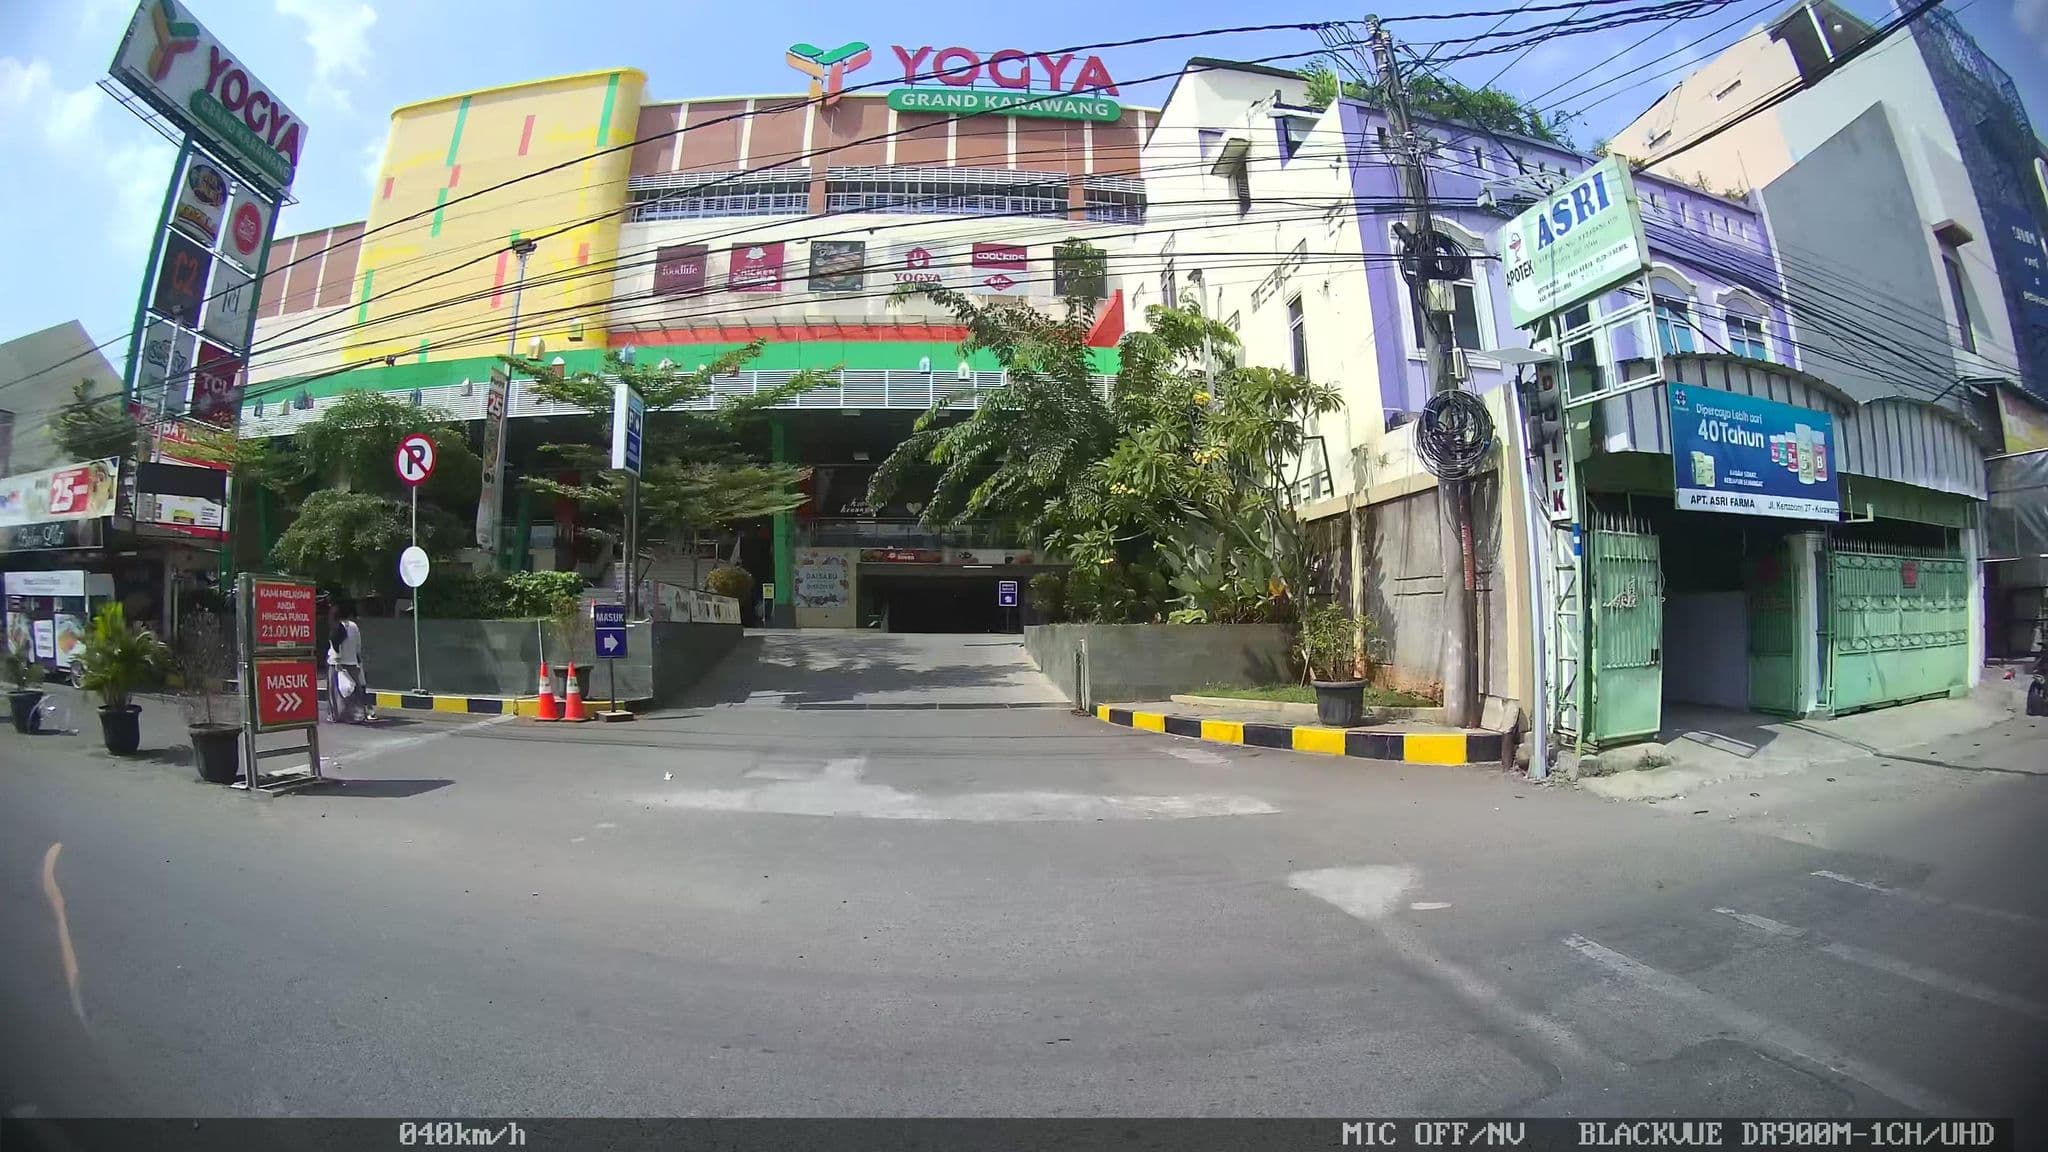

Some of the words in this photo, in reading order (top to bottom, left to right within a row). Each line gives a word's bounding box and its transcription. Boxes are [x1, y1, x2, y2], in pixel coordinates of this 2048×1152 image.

[890, 45, 1120, 97] YOGYA
[204, 45, 301, 168] YOGYA
[901, 93, 978, 108] GRAND
[984, 95, 1109, 117] KARAWANG
[1537, 171, 1610, 251] ASRI
[894, 273, 941, 282] YOGYA
[1506, 259, 1534, 288] APOTEK
[201, 373, 229, 394] TCL
[1698, 419, 1719, 442] 40
[1718, 422, 1765, 449] Tahun
[1690, 494, 1708, 506] APT.
[1710, 496, 1728, 507] ASRI
[1730, 497, 1755, 509] FARMA
[260, 588, 279, 598] KAMI
[595, 612, 625, 623] MASUK
[262, 625, 288, 637] 21.00
[289, 625, 310, 638] WIB
[266, 673, 309, 690] MASUK
